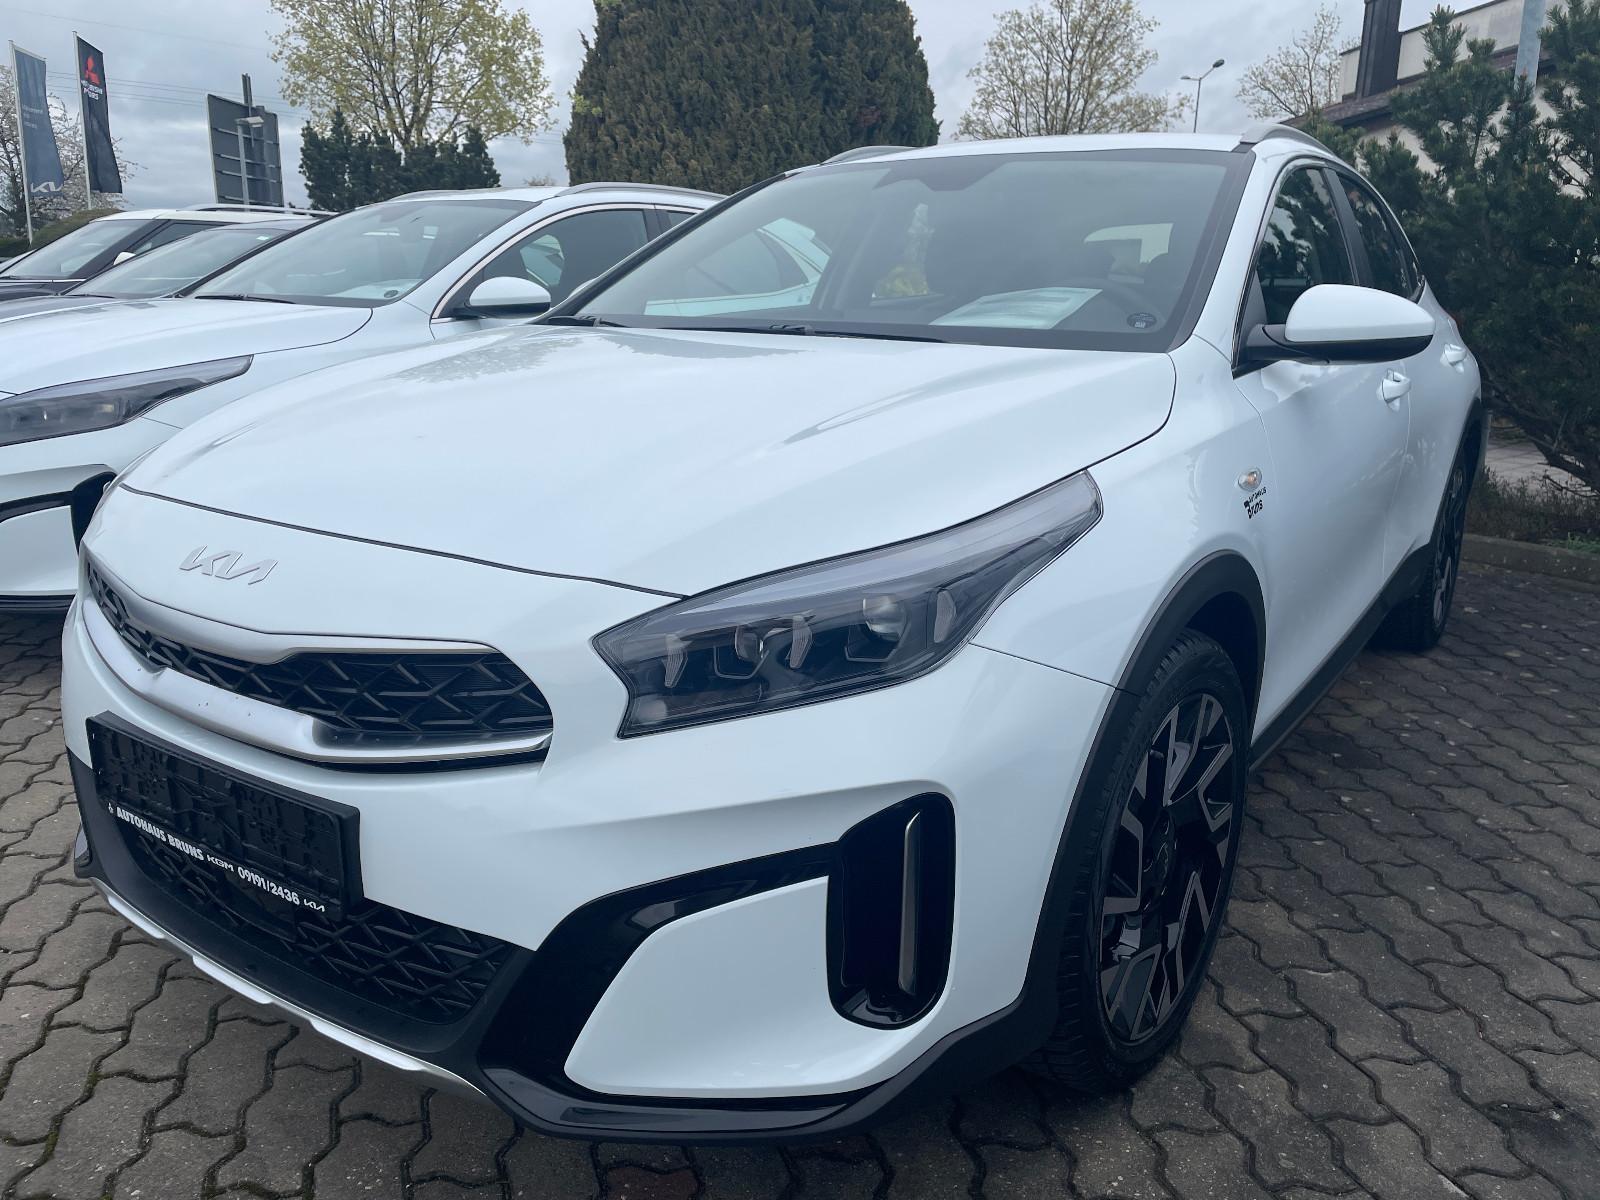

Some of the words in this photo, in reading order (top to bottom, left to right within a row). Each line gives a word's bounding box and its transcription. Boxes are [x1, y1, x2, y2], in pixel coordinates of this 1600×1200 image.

[178, 544, 279, 586] KIA
[116, 806, 166, 842] AUTOHAUS
[167, 833, 204, 861] BRUNS
[206, 854, 234, 872] KGM
[237, 866, 300, 905] 09191/2436
[303, 898, 325, 912] KIA
